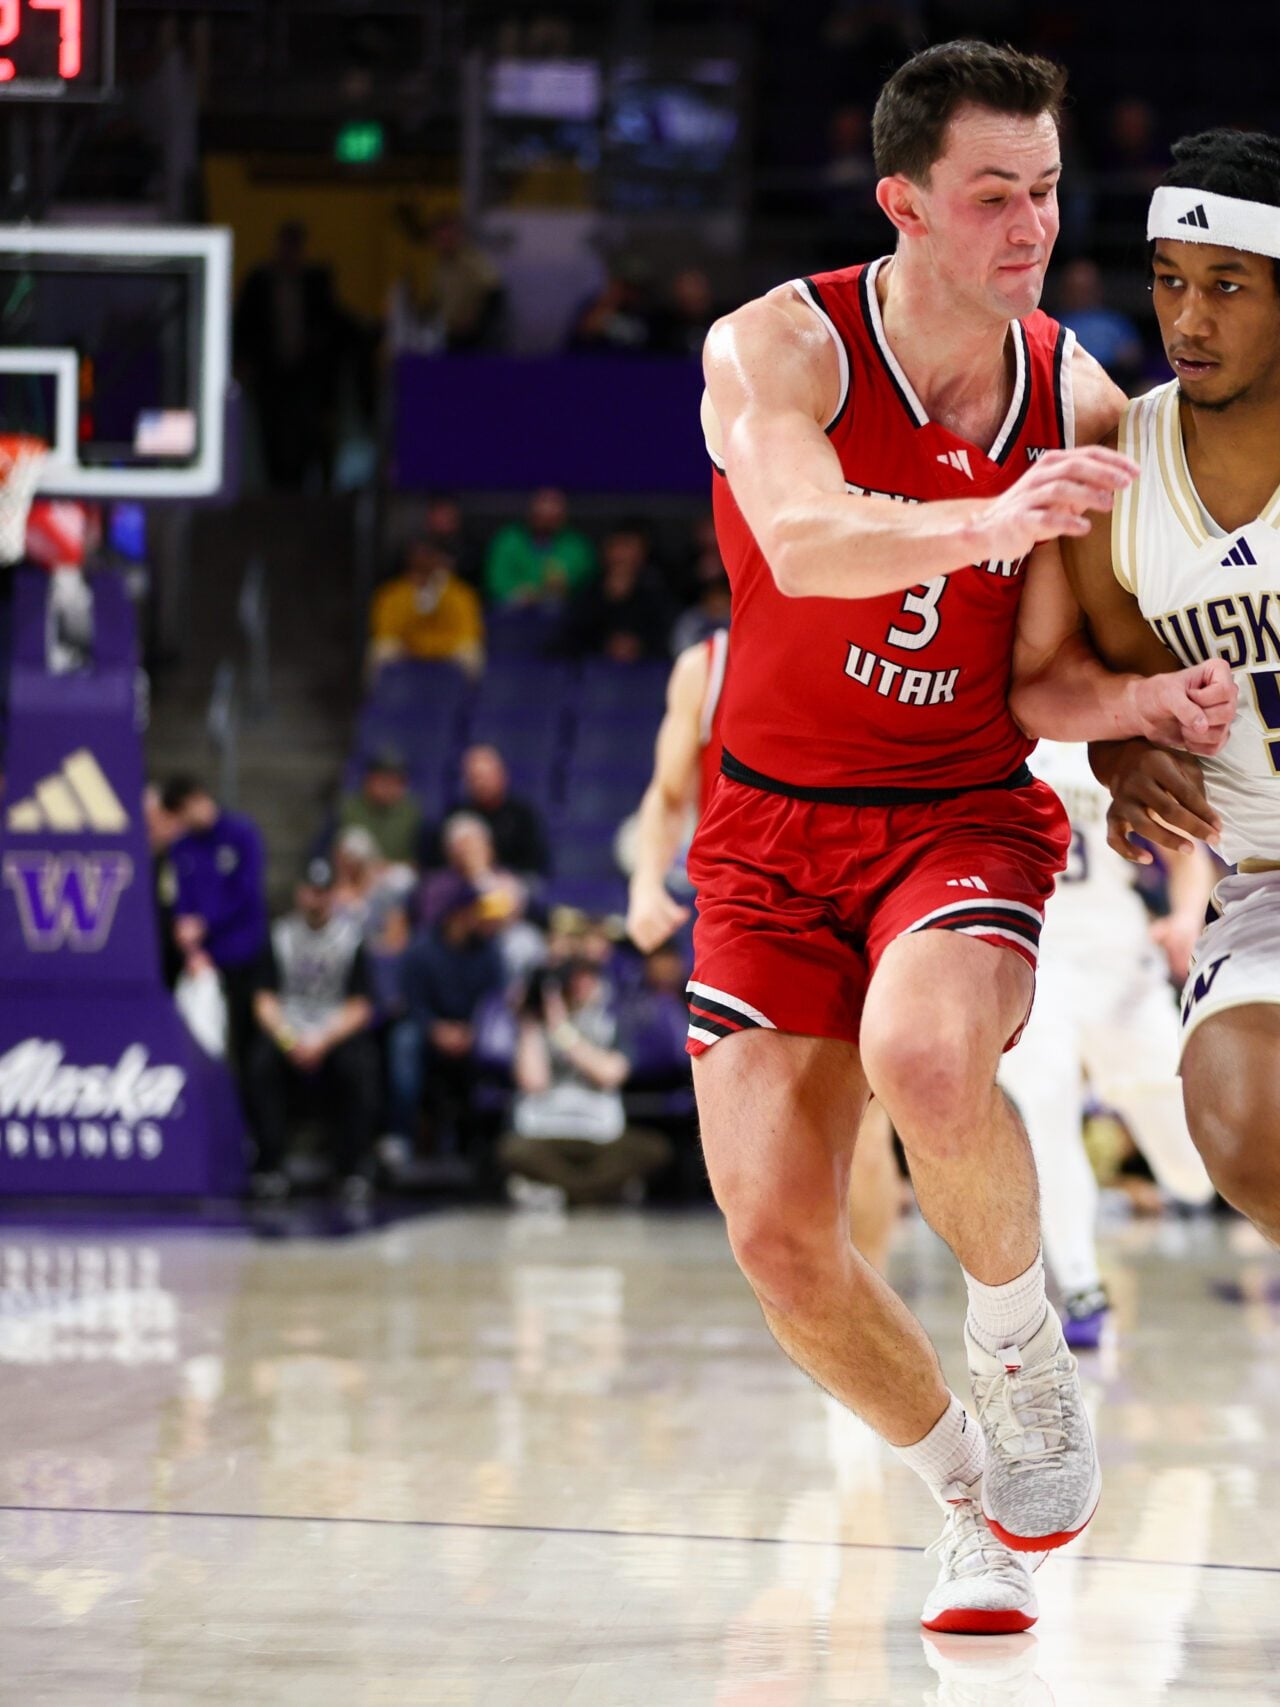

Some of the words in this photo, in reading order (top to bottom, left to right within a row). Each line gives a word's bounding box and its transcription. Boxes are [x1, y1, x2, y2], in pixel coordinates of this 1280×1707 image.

[887, 574, 948, 651] 3
[844, 641, 961, 706] UTAH
[4, 851, 134, 952] W
